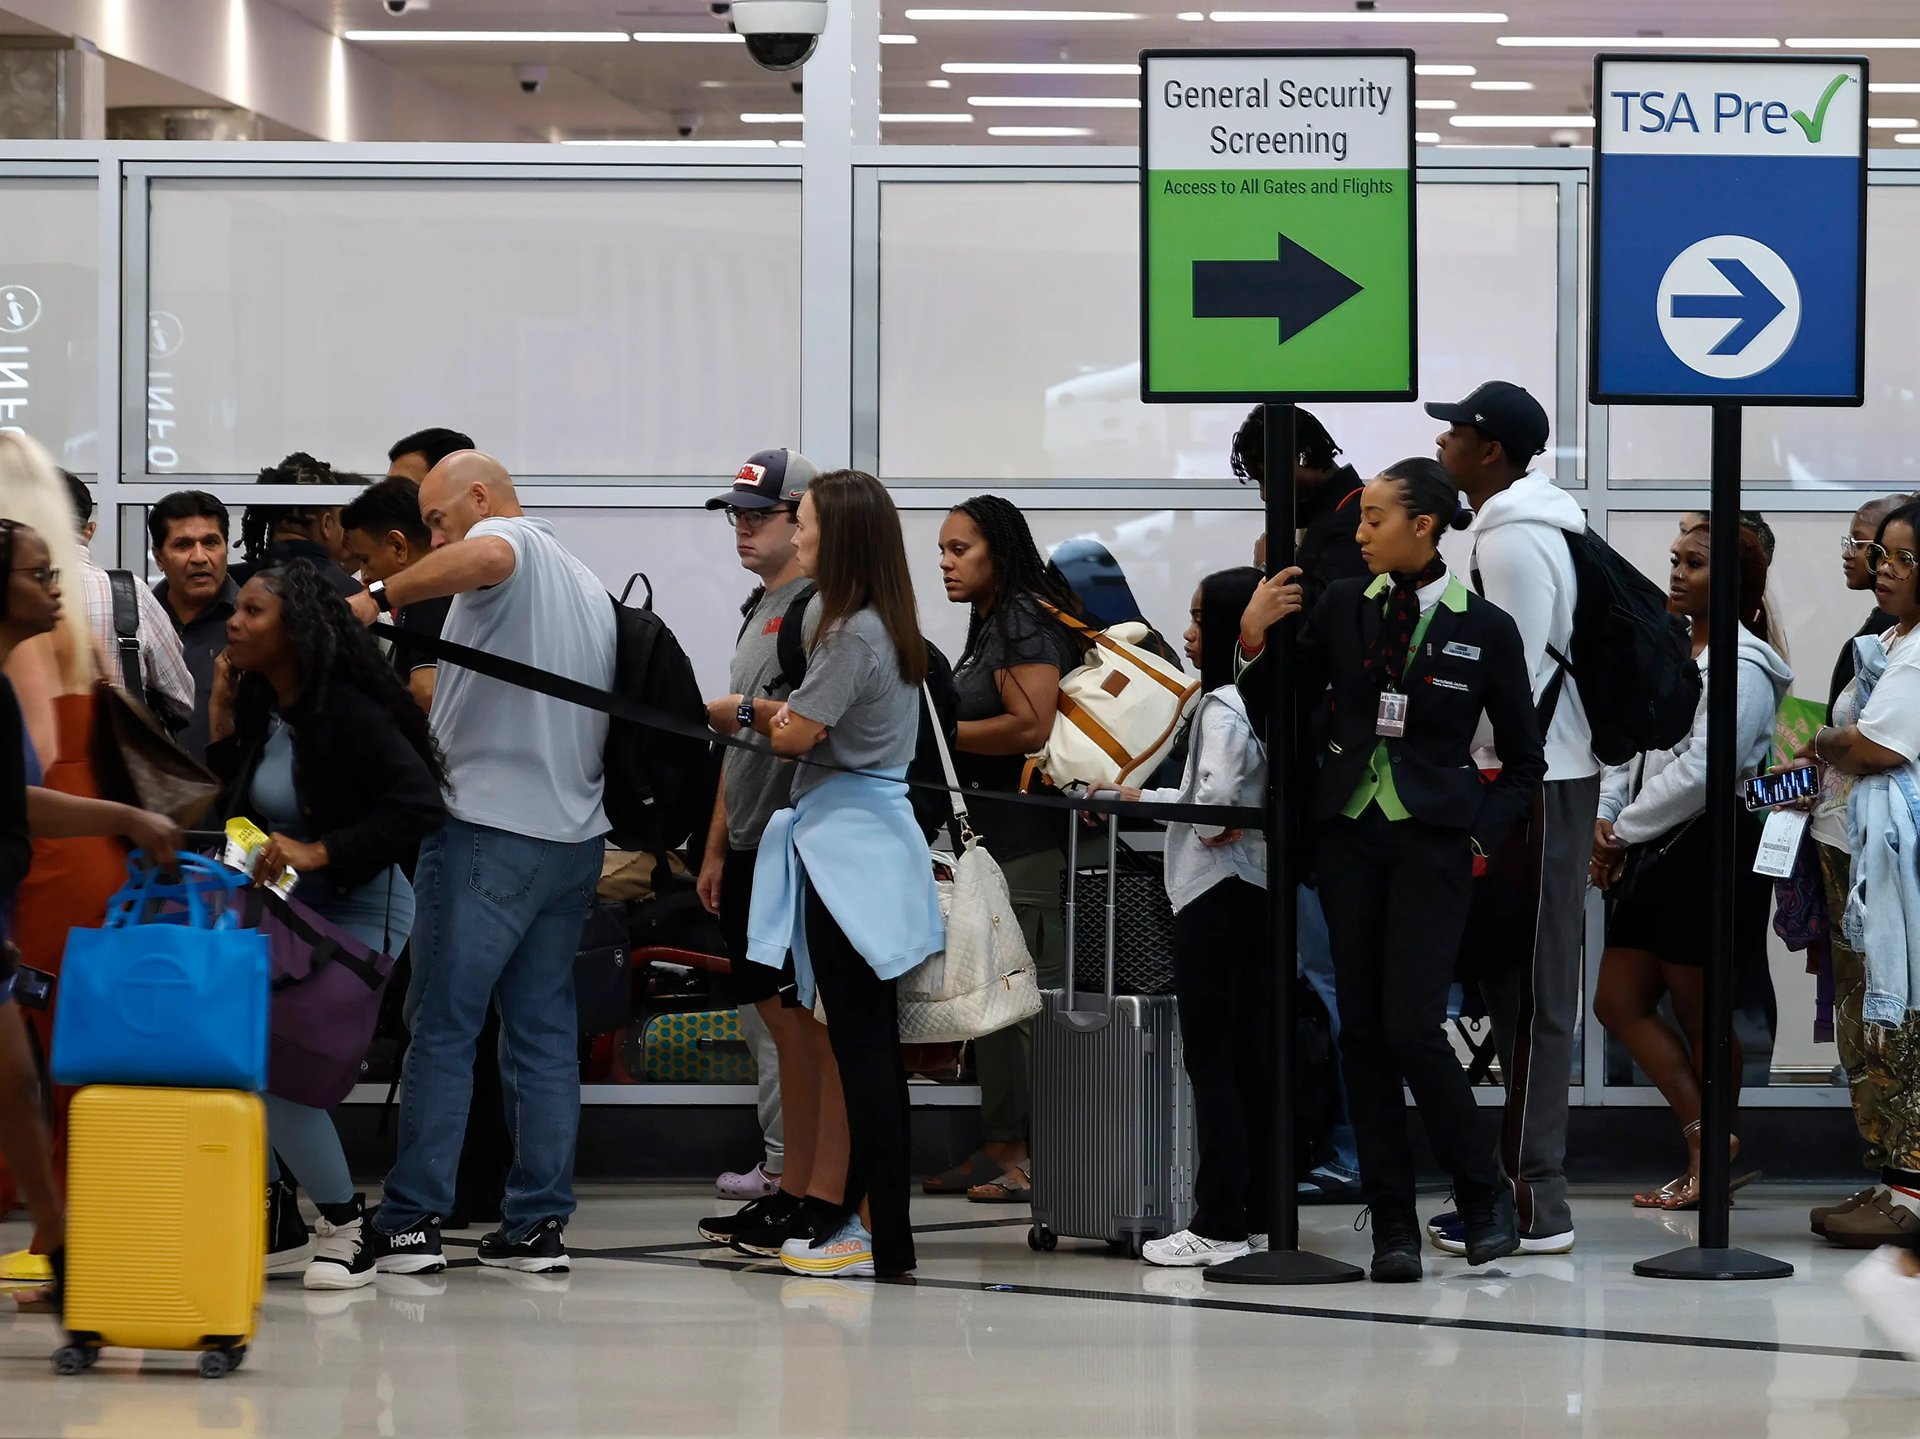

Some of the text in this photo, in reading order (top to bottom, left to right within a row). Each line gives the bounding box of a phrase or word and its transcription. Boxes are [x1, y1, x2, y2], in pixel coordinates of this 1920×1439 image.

[1164, 77, 1392, 115] General Security
[1610, 91, 1700, 133] TSA
[1713, 91, 1788, 134] Pre
[1210, 124, 1347, 161] Screening
[1164, 178, 1393, 197] Access to All Gates and Flights
[390, 1231, 427, 1248] HOKA
[823, 1239, 865, 1255] HOKA
